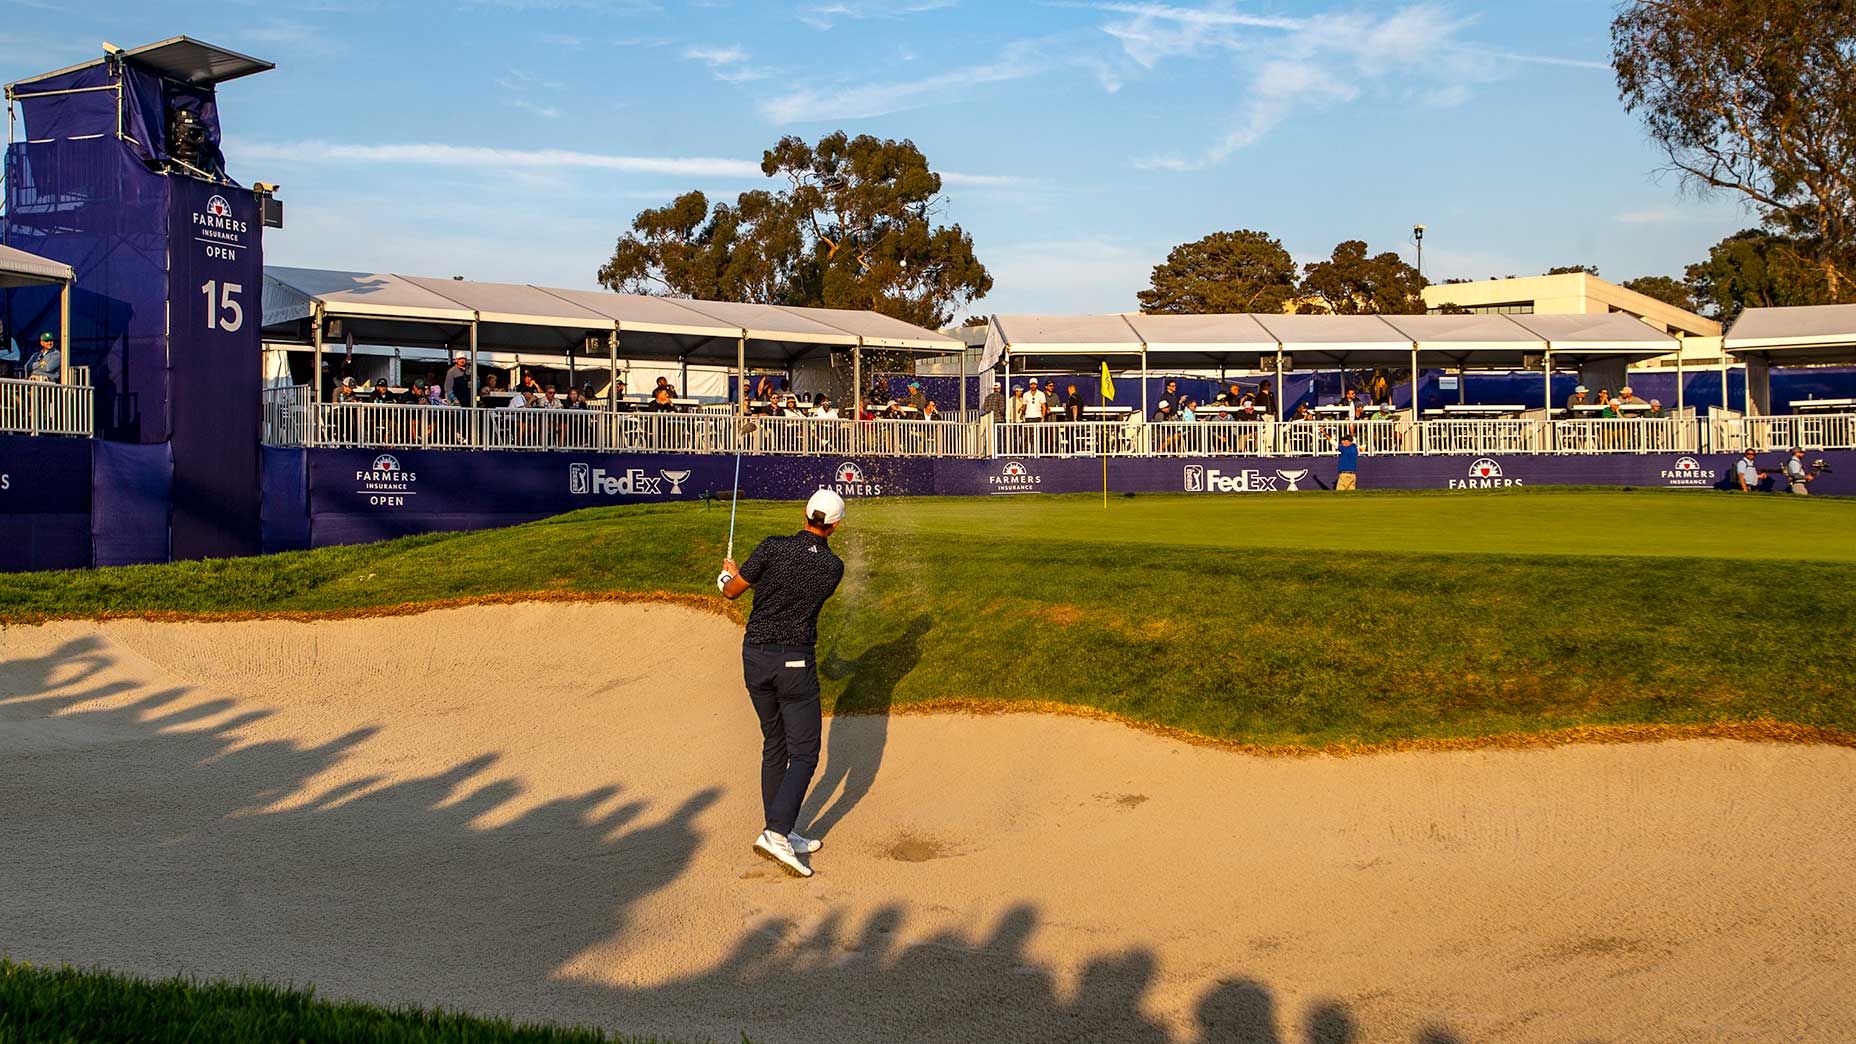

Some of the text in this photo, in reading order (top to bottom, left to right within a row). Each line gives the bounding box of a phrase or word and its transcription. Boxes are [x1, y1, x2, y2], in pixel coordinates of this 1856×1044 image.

[193, 212, 247, 233] FARMERS
[202, 229, 238, 241] INSURANCE
[206, 246, 236, 260] OPEN
[201, 280, 243, 332] 15
[356, 471, 417, 482] FARMERS
[989, 476, 1041, 484] FARMERS
[1661, 470, 1715, 478] FARMERS
[592, 469, 662, 495] FedEx
[1206, 469, 1278, 492] FedEx
[1449, 479, 1523, 489] FARMERS
[370, 496, 404, 506] OPEN
